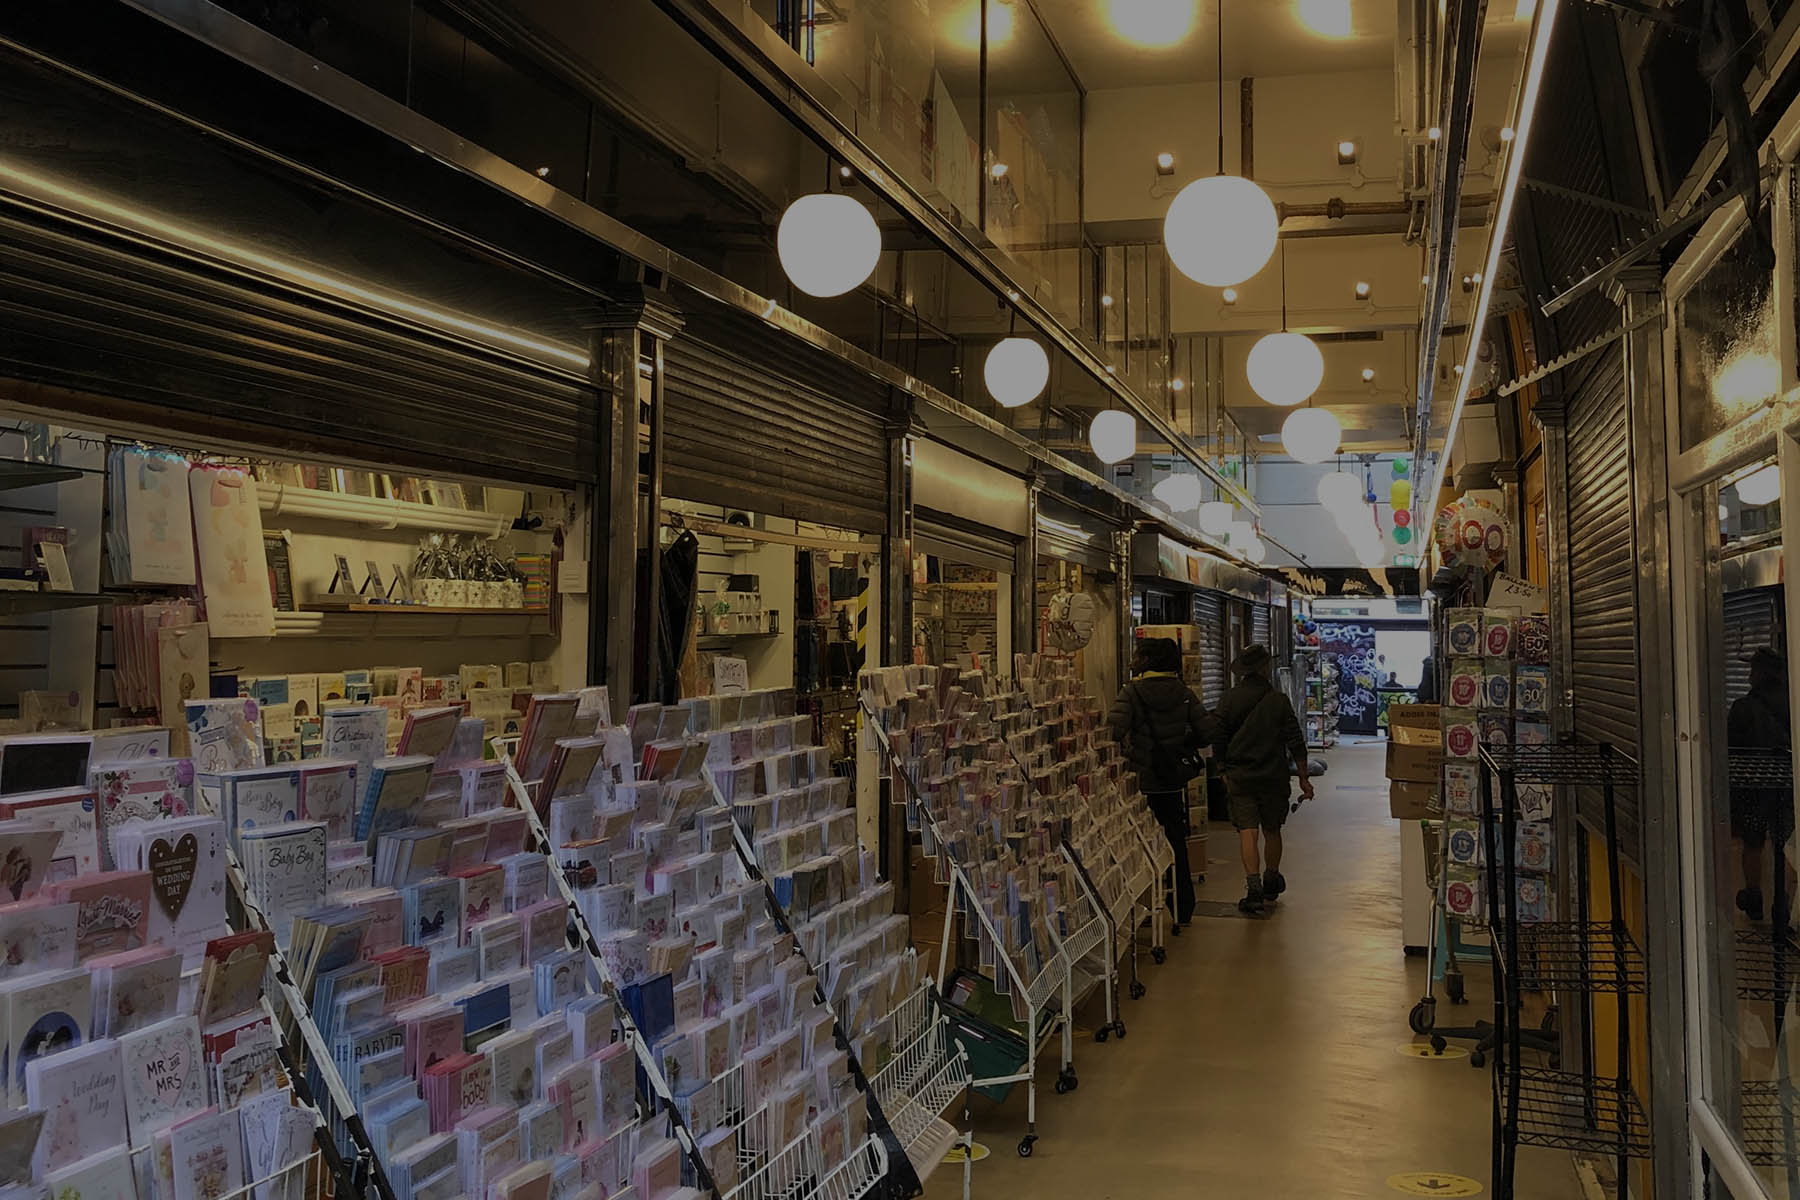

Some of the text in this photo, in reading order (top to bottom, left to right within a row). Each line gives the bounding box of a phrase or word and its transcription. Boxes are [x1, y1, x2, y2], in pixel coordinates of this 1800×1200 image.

[268, 845, 315, 873] Baby Boy
[156, 870, 192, 887] WEDDING
[167, 884, 181, 897] DAY
[146, 1060, 167, 1080] MR
[72, 1072, 116, 1097] Wedding
[156, 1072, 182, 1096] MRS
